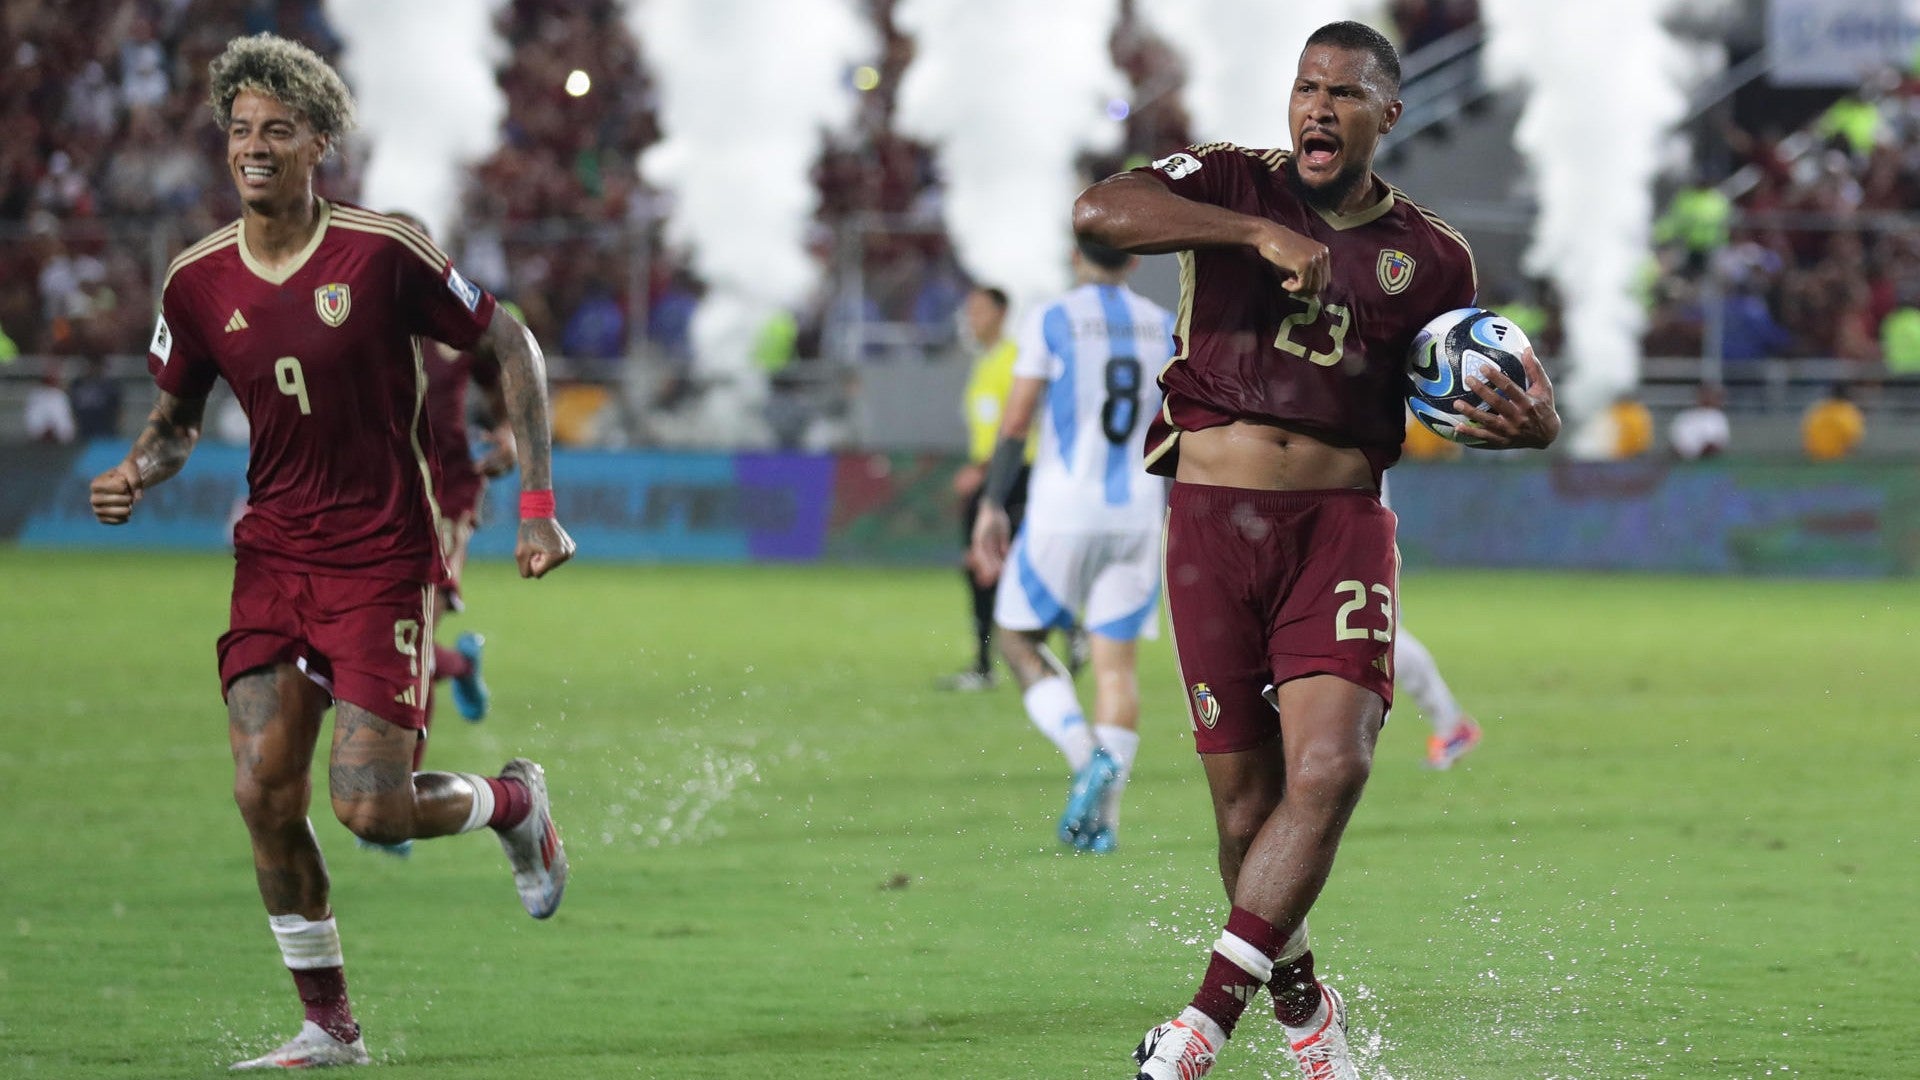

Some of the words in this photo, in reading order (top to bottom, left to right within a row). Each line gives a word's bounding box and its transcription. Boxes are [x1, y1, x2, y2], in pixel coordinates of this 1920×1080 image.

[1273, 292, 1351, 367] 23
[275, 356, 312, 415] 9
[1103, 357, 1142, 444] 8
[1334, 580, 1393, 643] 23
[394, 619, 419, 677] 9
